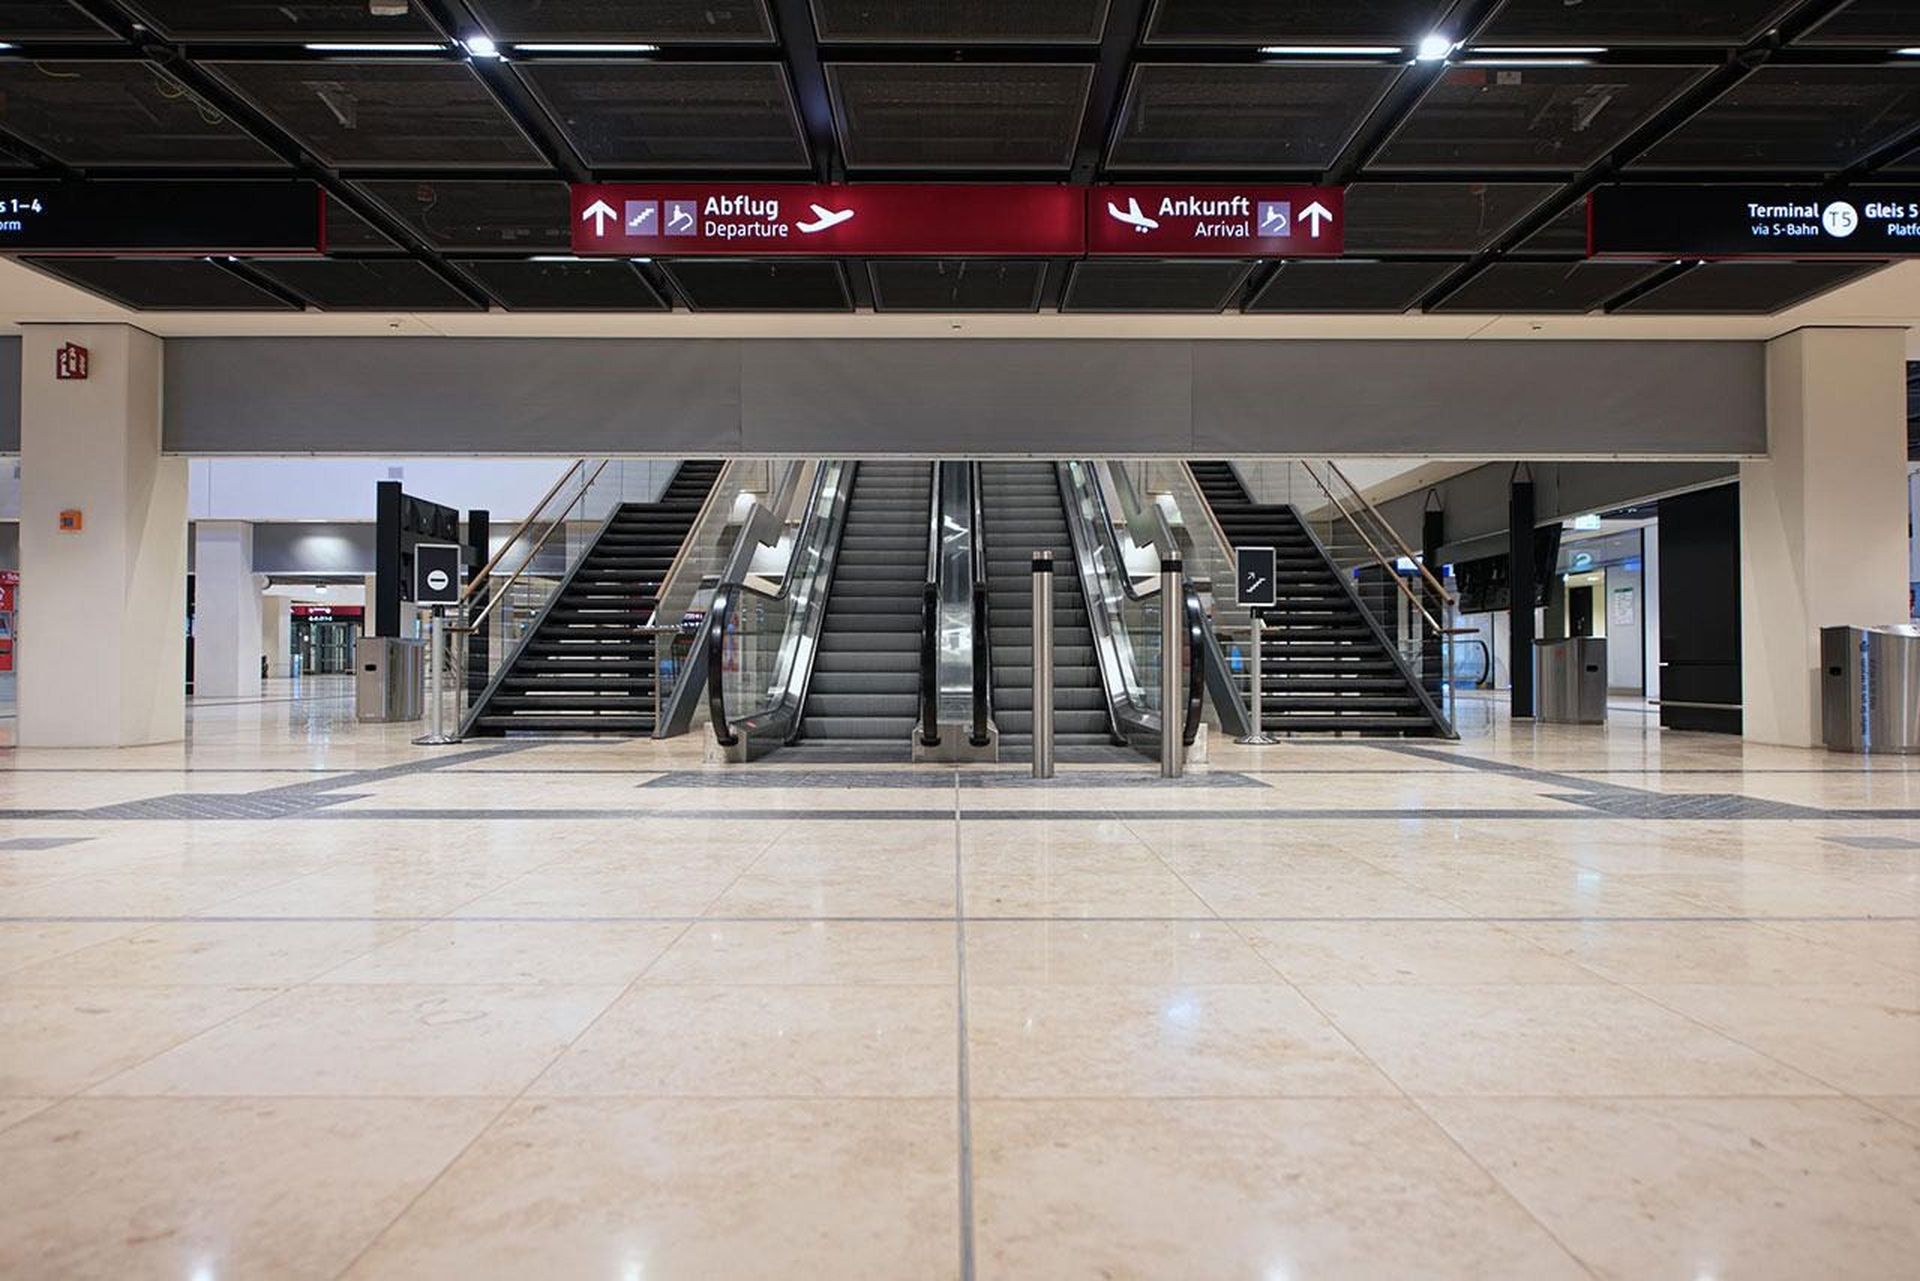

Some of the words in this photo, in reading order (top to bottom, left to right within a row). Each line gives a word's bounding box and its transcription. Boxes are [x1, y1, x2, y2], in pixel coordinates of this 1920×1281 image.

[704, 195, 778, 221] Abflug
[1159, 196, 1249, 216] Ankunft
[1747, 202, 1819, 218] Terminal
[1865, 202, 1905, 218] Gleis
[1909, 203, 1919, 218] 5
[705, 221, 788, 240] Departure
[1195, 220, 1249, 237] Arrival
[1752, 222, 1770, 236] via
[1773, 222, 1819, 236] S-Bahn
